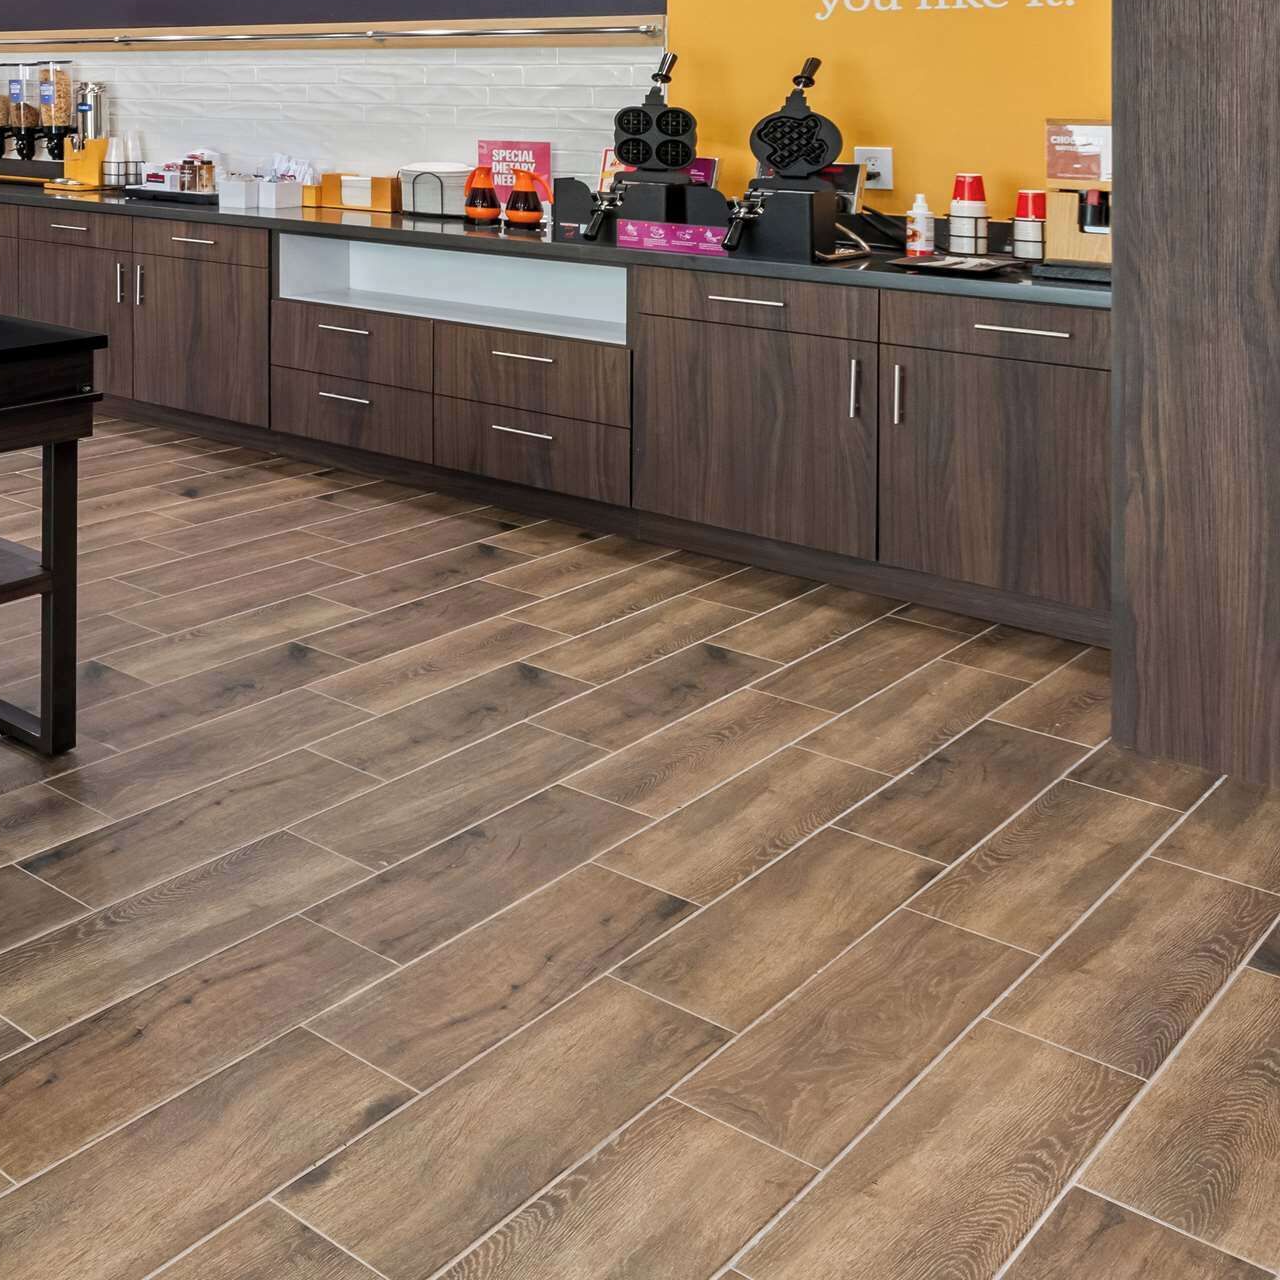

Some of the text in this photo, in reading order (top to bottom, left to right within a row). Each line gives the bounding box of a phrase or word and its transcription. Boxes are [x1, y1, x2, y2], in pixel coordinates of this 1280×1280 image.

[492, 149, 535, 162] SPECIAL
[492, 161, 536, 174] DIETARY
[493, 174, 516, 186] NEE
